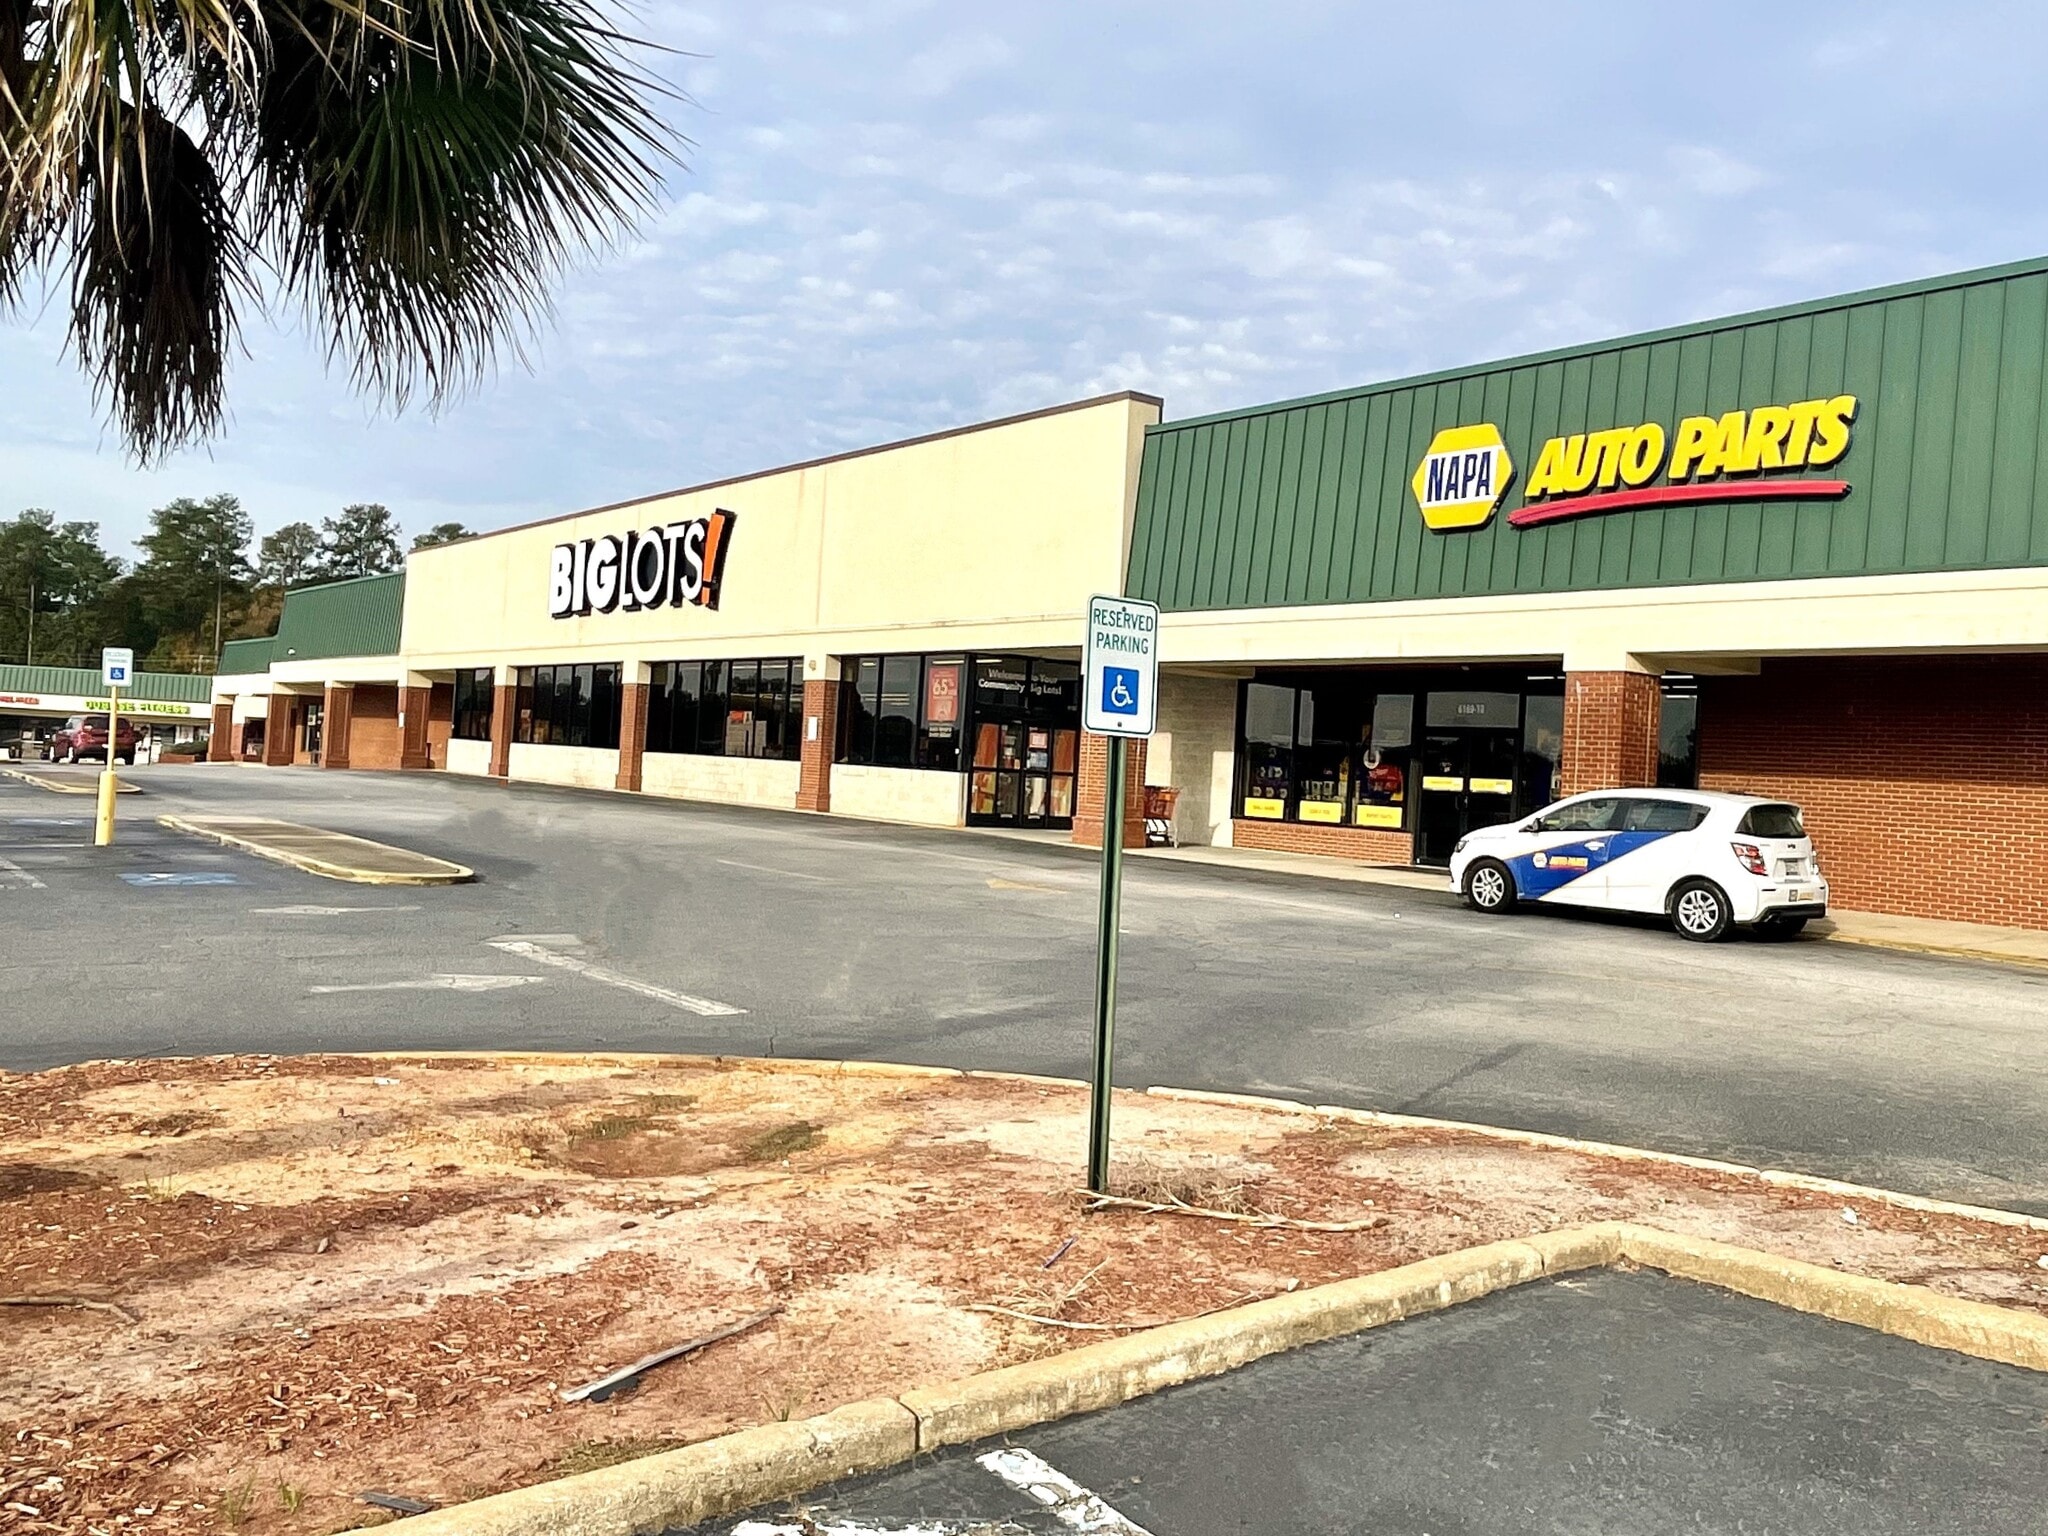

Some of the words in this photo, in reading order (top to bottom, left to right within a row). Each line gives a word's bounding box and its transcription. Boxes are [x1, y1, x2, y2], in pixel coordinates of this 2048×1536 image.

[1524, 422, 1666, 498] AUTO
[1669, 394, 1858, 481] PARTS
[1426, 450, 1492, 503] NAPA
[1093, 608, 1154, 632] RESERVED
[1096, 631, 1149, 655] PARKING
[978, 678, 1026, 694] Community
[1040, 674, 1058, 684] Your
